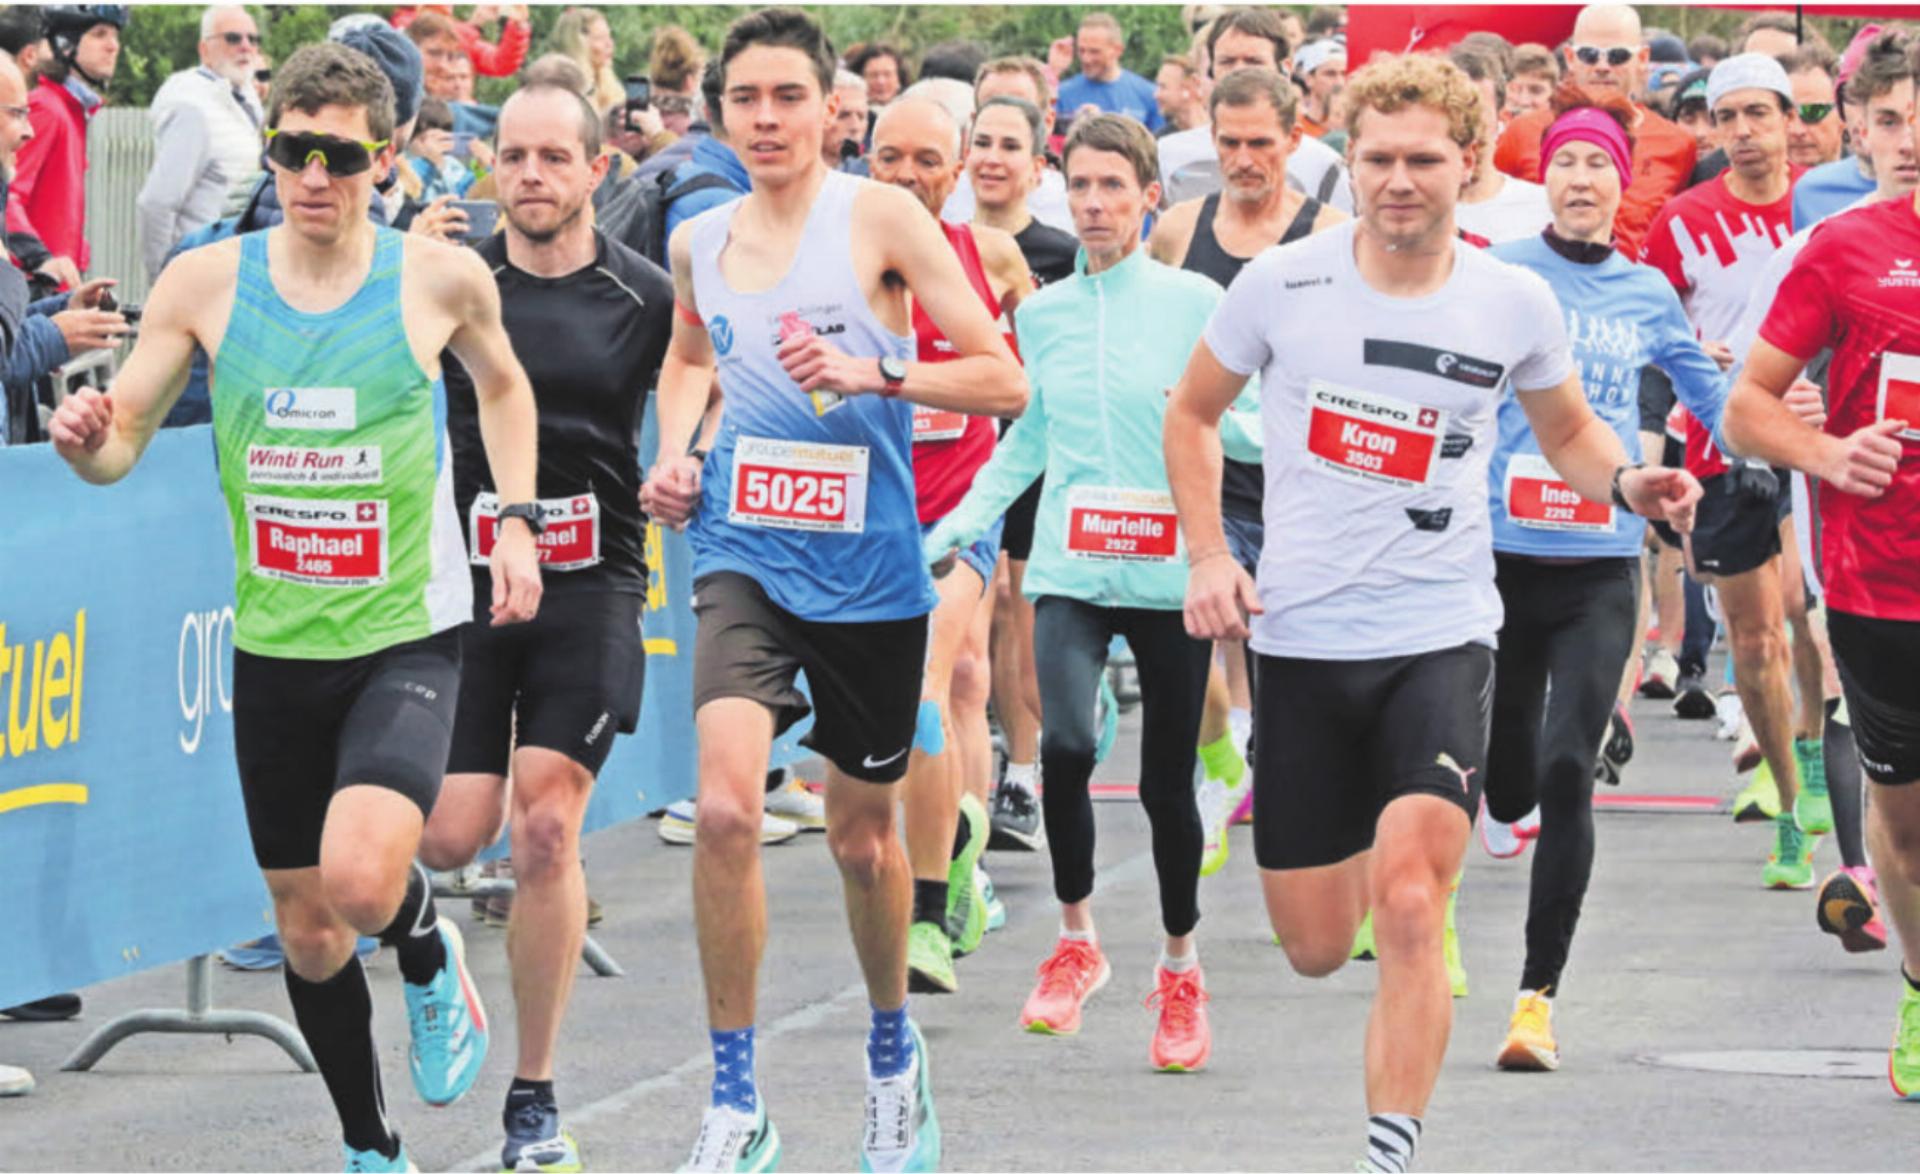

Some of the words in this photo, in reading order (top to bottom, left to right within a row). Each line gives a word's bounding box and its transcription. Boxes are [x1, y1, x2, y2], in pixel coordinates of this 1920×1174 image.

[1316, 391, 1409, 422] CRESPO
[1341, 421, 1398, 456] Kron
[250, 449, 297, 469] Winti
[303, 451, 344, 469] Run
[745, 470, 845, 517] 5025
[1541, 483, 1582, 506] Ines
[254, 505, 347, 521] CRESPO
[1082, 512, 1165, 538] Murielle
[269, 526, 364, 563] Raphael
